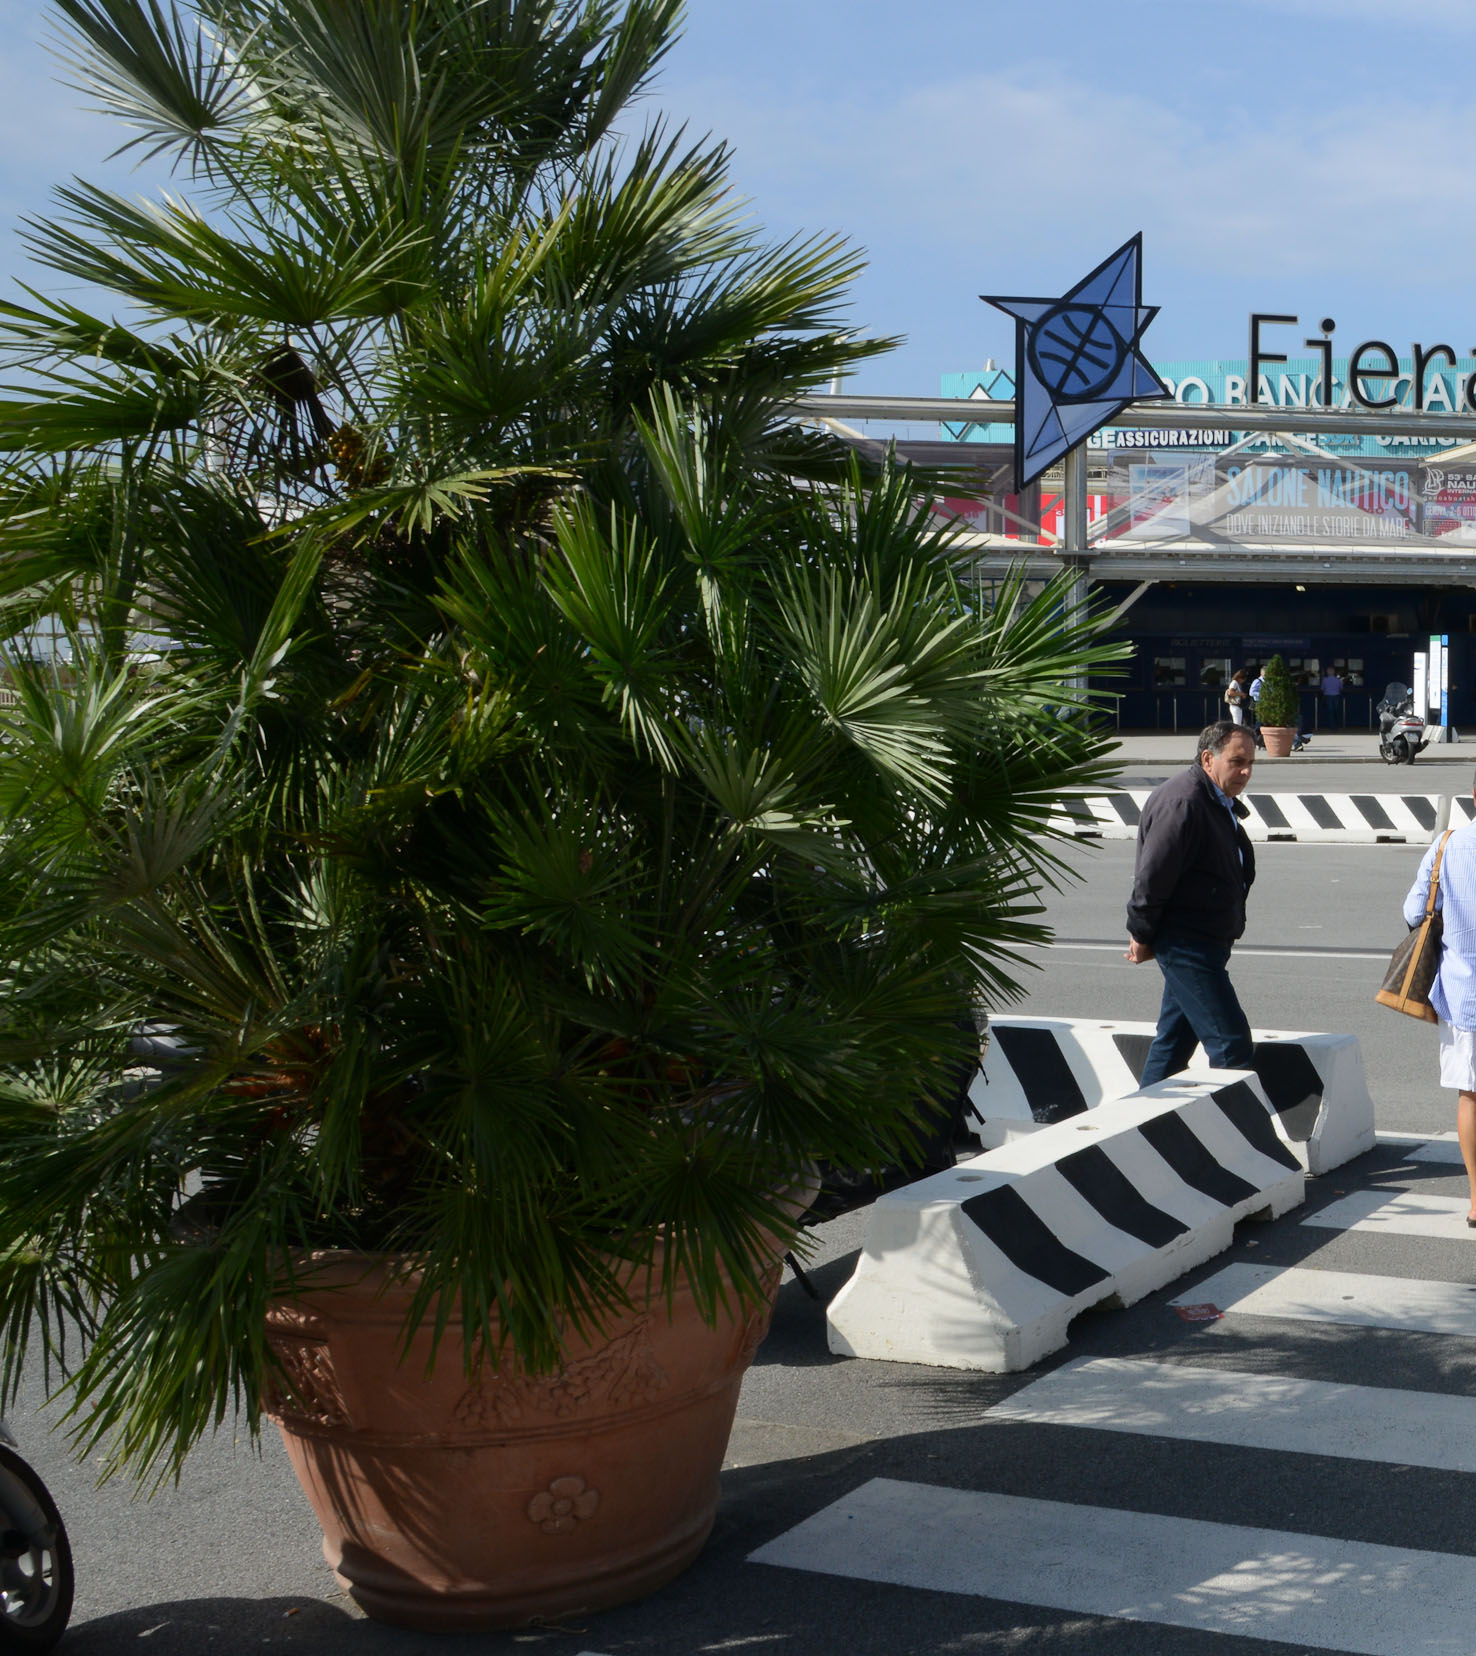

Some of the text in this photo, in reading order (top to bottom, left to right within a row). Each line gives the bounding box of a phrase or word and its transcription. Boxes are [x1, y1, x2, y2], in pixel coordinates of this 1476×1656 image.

[1116, 429, 1230, 448] ASSICURAZIONI
[1227, 466, 1310, 508] SALONE
[1226, 513, 1255, 535] DOVE
[1258, 514, 1304, 536] INIZIANO
[1306, 514, 1320, 537] LE
[1323, 515, 1360, 538] STORIE
[1363, 517, 1377, 537] DA
